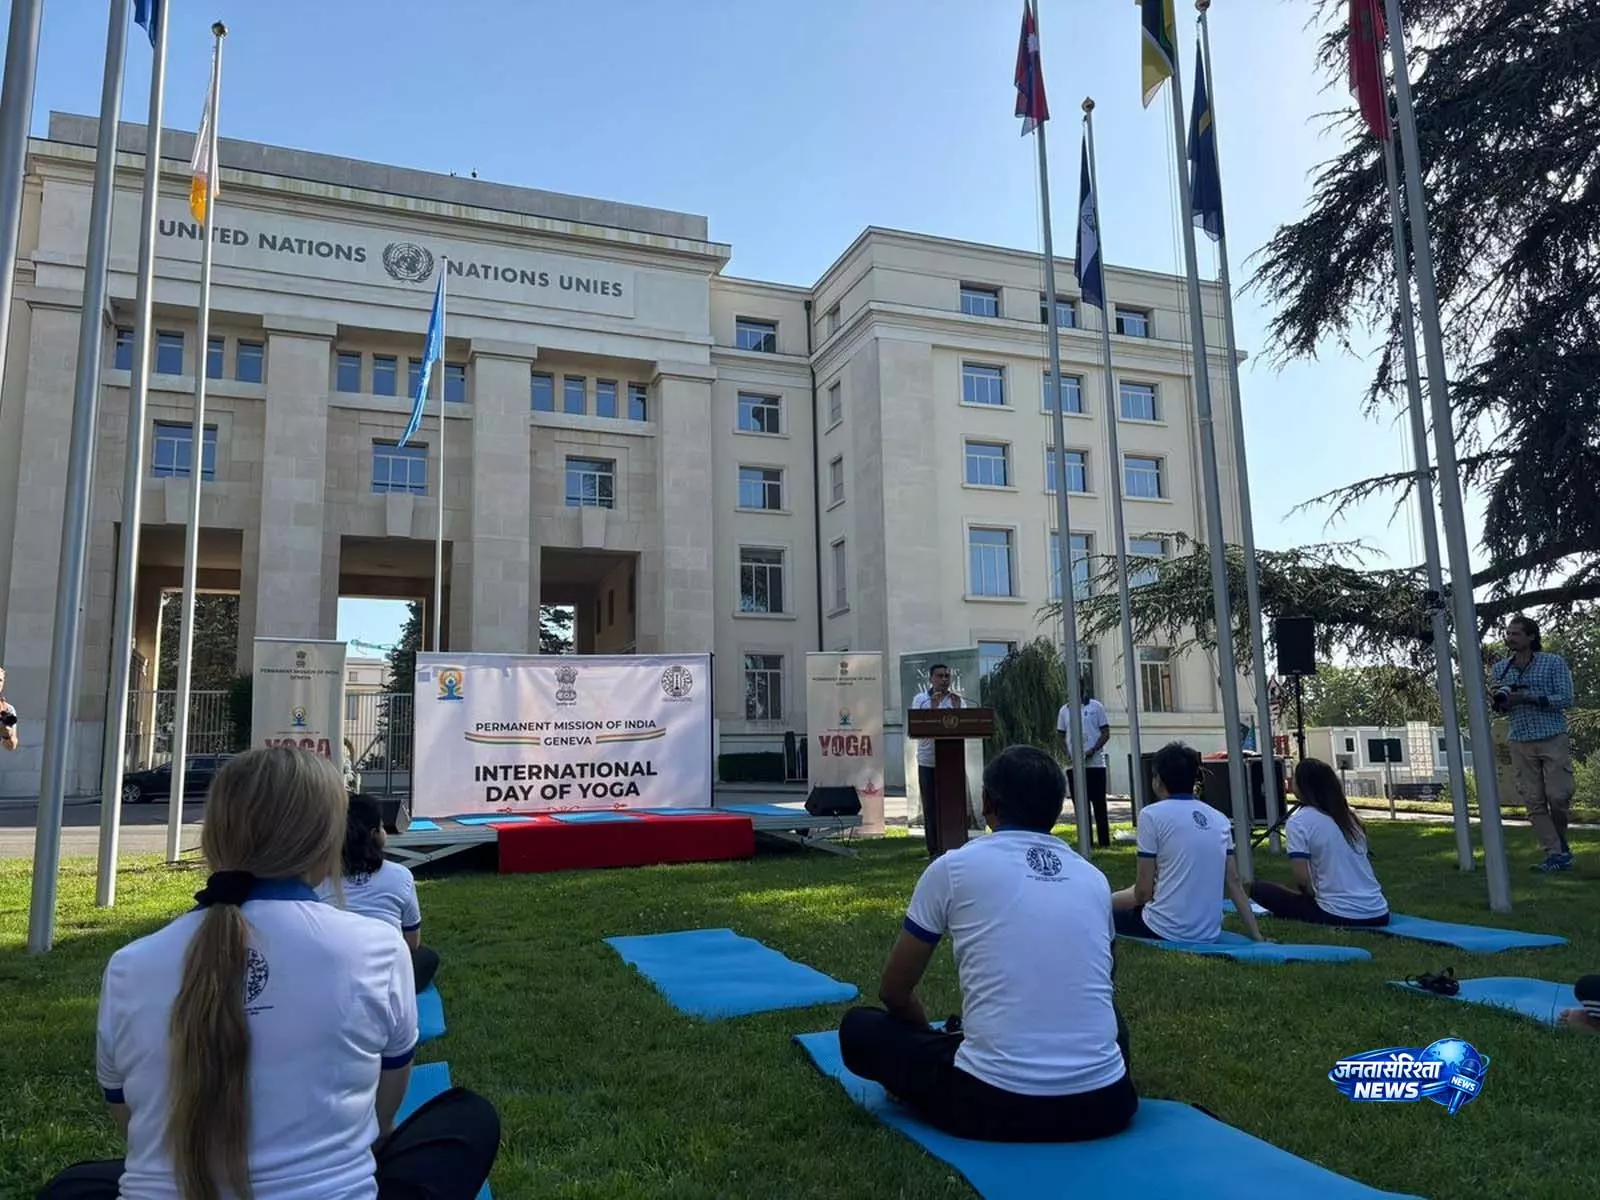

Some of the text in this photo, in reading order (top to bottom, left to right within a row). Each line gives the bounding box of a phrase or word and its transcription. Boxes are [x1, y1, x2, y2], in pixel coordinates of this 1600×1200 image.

[159, 219, 367, 263] UNITED NATIONS
[447, 260, 623, 297] NATIONS UNIES
[475, 719, 657, 732] PERMANENT MISSION OF INDIA
[544, 736, 592, 746] GENEVA
[818, 734, 873, 756] YOGA
[475, 761, 658, 782] INTERNATIONAL
[485, 781, 640, 802] DAY OF YOGA
